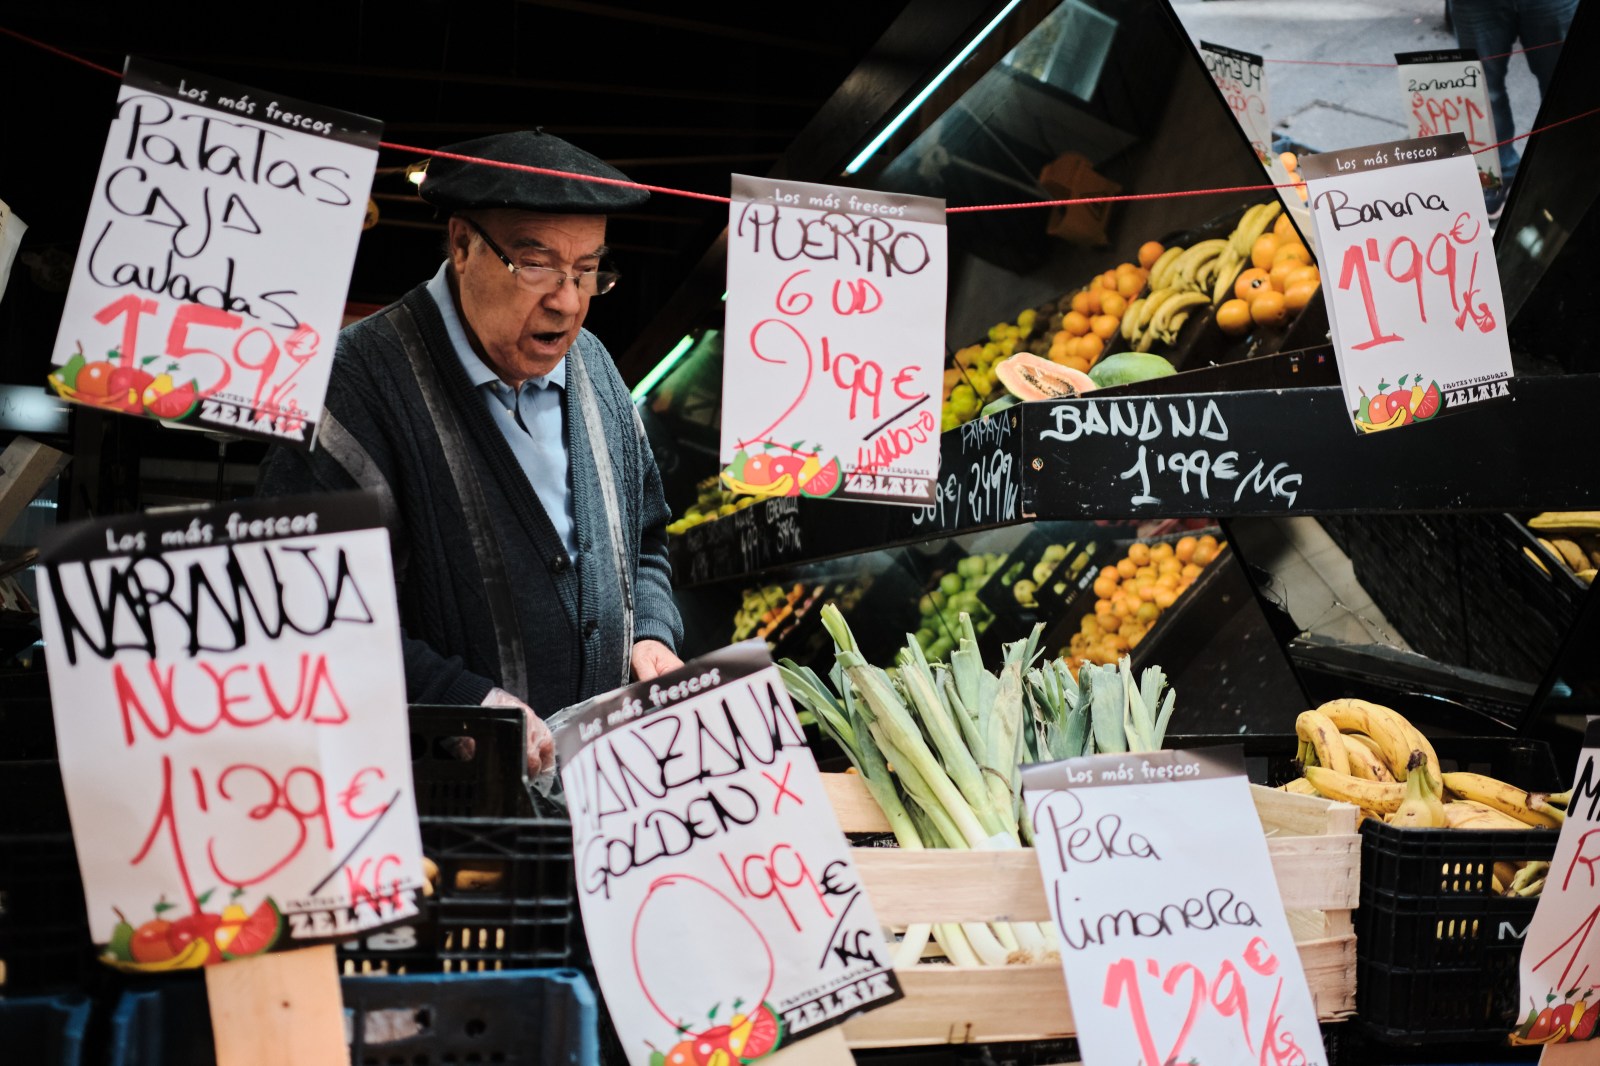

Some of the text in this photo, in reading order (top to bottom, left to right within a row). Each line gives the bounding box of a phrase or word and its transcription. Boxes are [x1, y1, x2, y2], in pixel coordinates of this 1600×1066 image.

[177, 79, 334, 136] Los más frescos
[1336, 146, 1438, 172] Los más frescos
[774, 188, 907, 217] Los más frescos
[737, 200, 931, 278] PUERRO
[775, 269, 884, 316] 6 UD
[1039, 398, 1229, 442] BANANA
[106, 510, 319, 553] Los más frescos
[46, 544, 374, 666] NARANJA
[112, 652, 349, 747] NUEVA
[578, 668, 721, 742] Los más frescos
[1065, 759, 1201, 784] Los más frescos
[582, 785, 758, 899] GOLDEN
